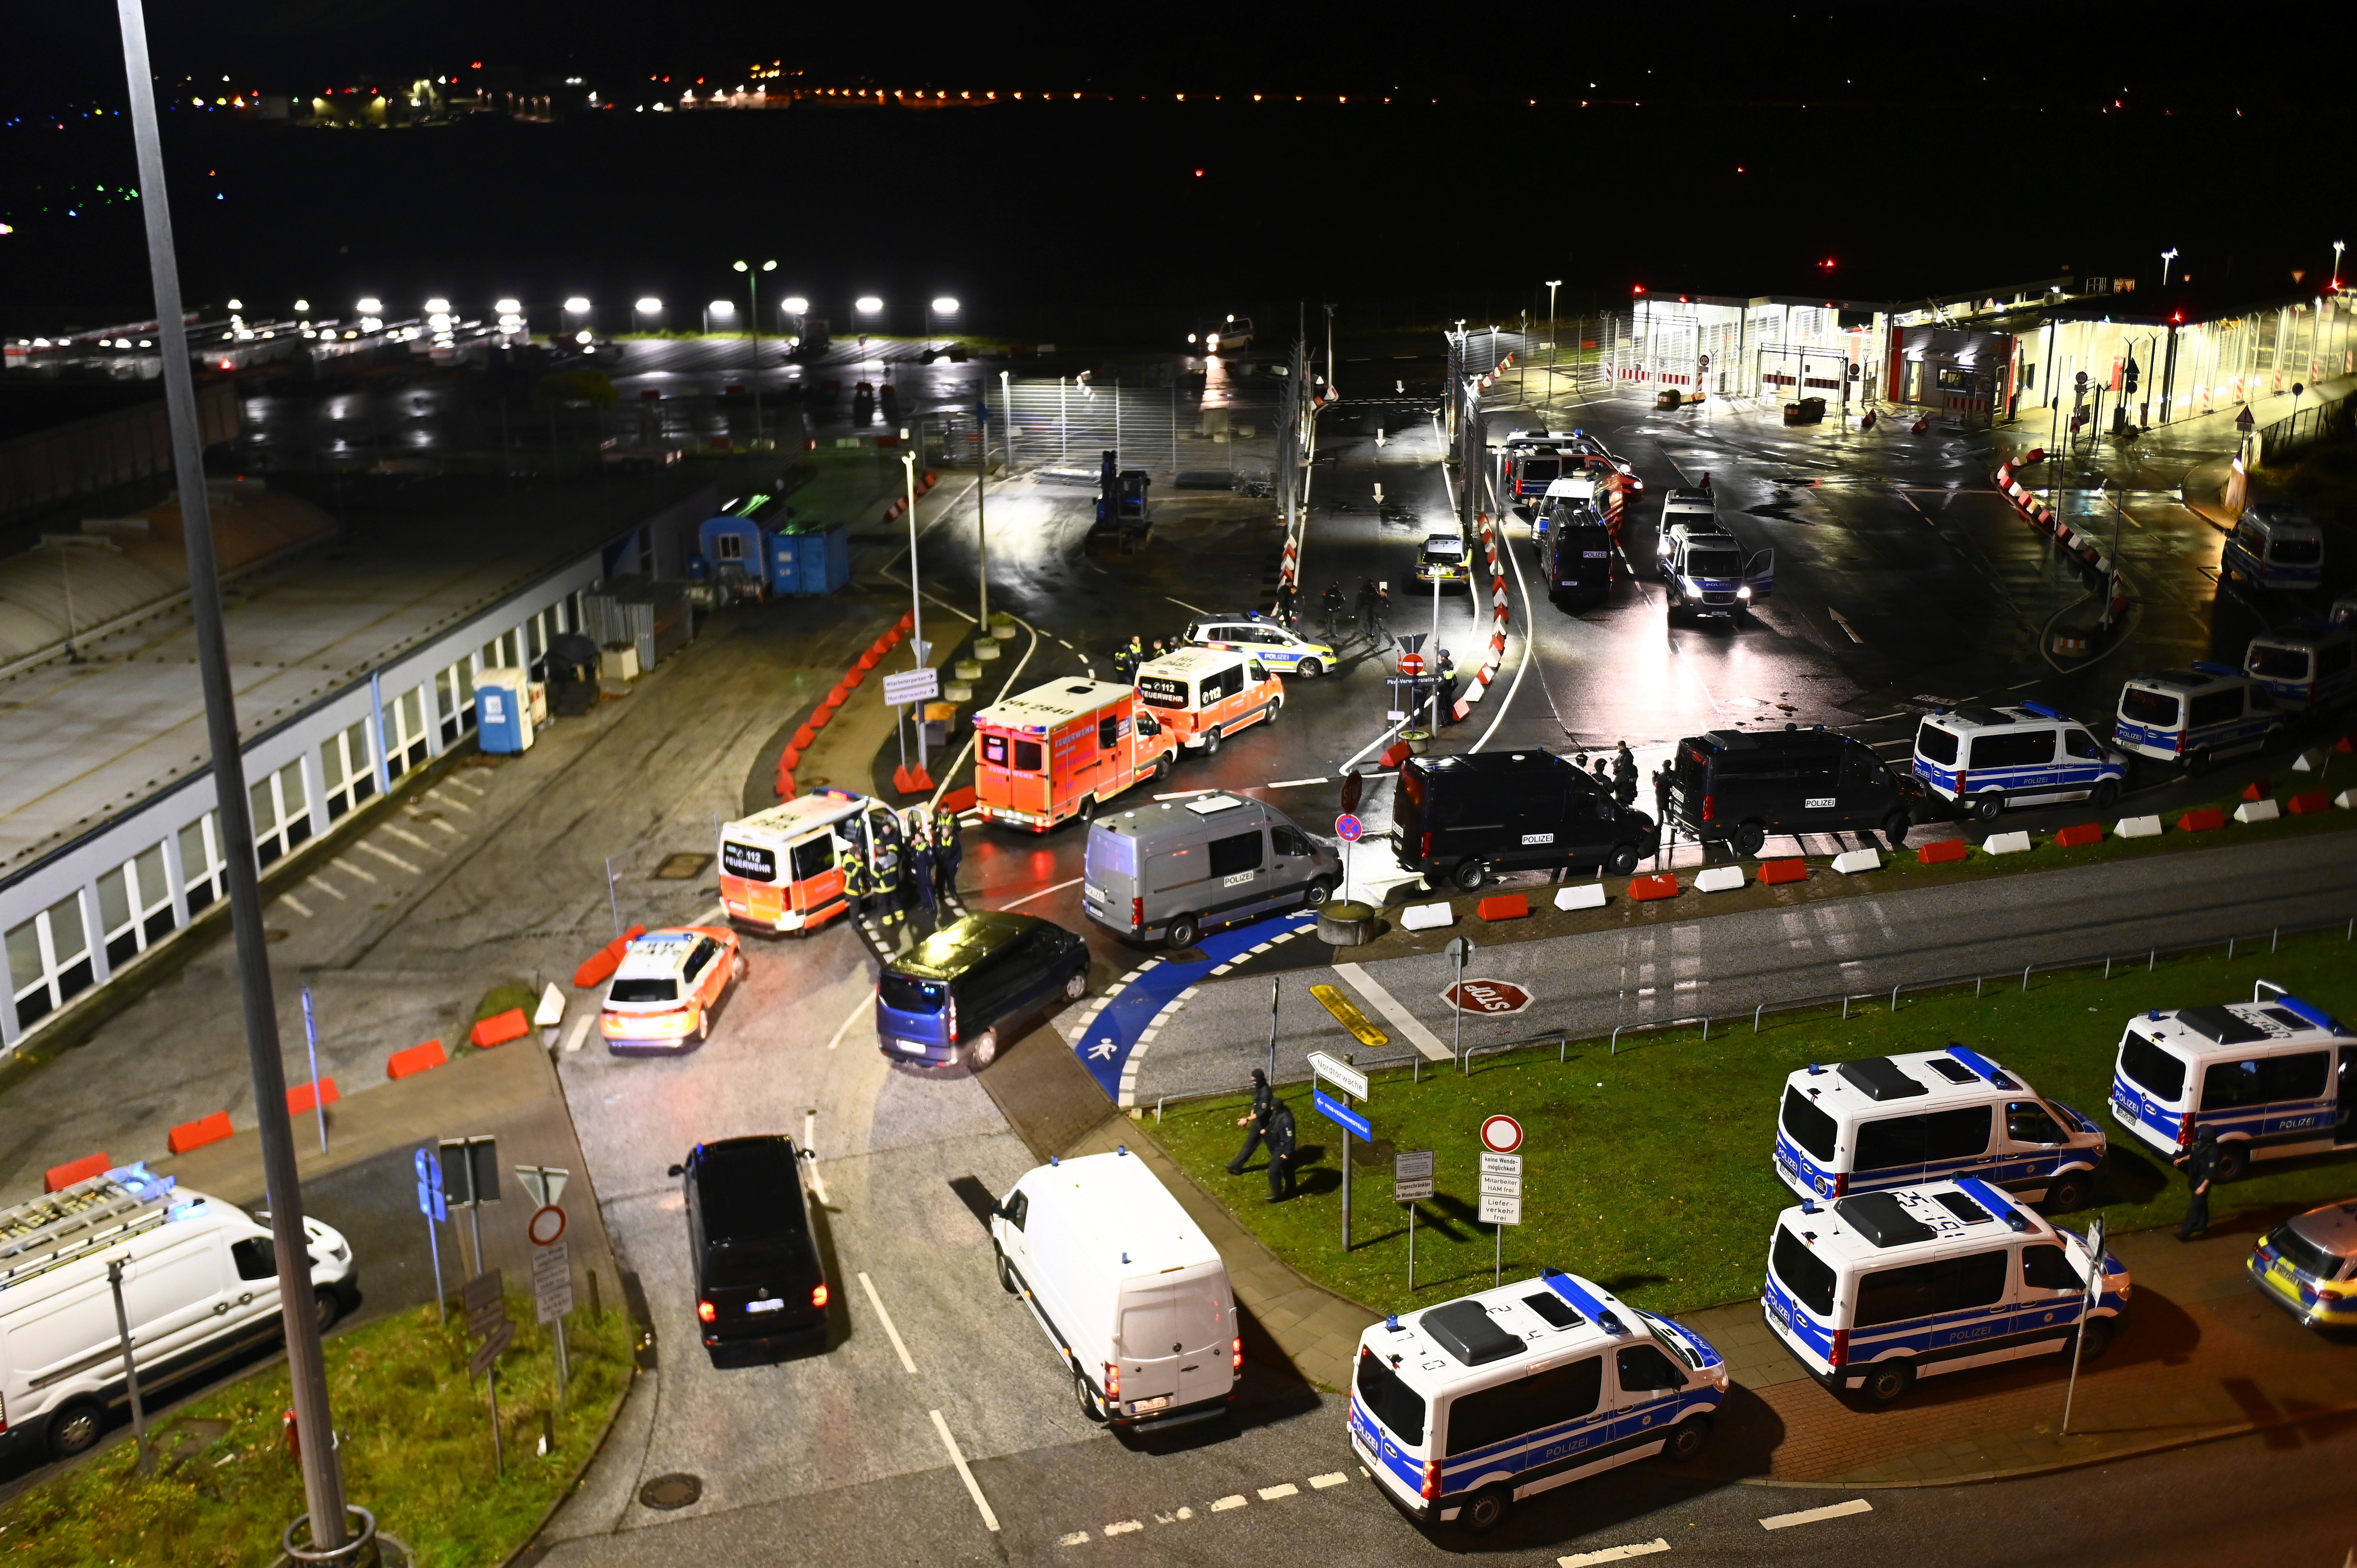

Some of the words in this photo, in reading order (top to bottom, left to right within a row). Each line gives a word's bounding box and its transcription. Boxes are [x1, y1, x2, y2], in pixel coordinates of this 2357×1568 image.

[888, 690, 927, 701] Nordtorwache
[1162, 683, 1175, 693] 112
[1209, 686, 1221, 701] 112
[1141, 690, 1184, 703] FEUERWEHR
[1055, 724, 1095, 748] FEUERWEHR
[2119, 730, 2142, 741] POLIZEI
[989, 765, 1034, 780] FEUERWEHR
[1915, 766, 1930, 779] POLIZEI
[1343, 780, 1362, 803] STOP
[1672, 787, 1683, 801] POLIZEI
[1392, 823, 1403, 836] POLIZEI
[1523, 834, 1553, 843] POLIZEI
[747, 850, 762, 863] 112
[726, 855, 772, 874] FEUERWEHR
[1225, 872, 1253, 885] POLIZEI
[1085, 886, 1104, 901] POLIZEI
[1464, 985, 1511, 1010] STOP
[1317, 1059, 1362, 1091] Nordtorwache
[2115, 1089, 2139, 1113] POLIZEI
[1325, 1103, 1368, 1134] PKW-VERWAHRSTELLE
[2279, 1117, 2315, 1130] POLIZEI
[1778, 1146, 1798, 1172] POLIZEI
[1398, 1182, 1431, 1190] Eingeschränkter
[1484, 1177, 1518, 1186] Mitarbeiter
[1767, 1290, 1790, 1322] POLIZEI
[1668, 1320, 1710, 1349] POLIZEI
[1949, 1326, 1991, 1342] POLIZEI
[1353, 1415, 1378, 1451] POLIZEI
[1546, 1436, 1588, 1458] POLIZEI
